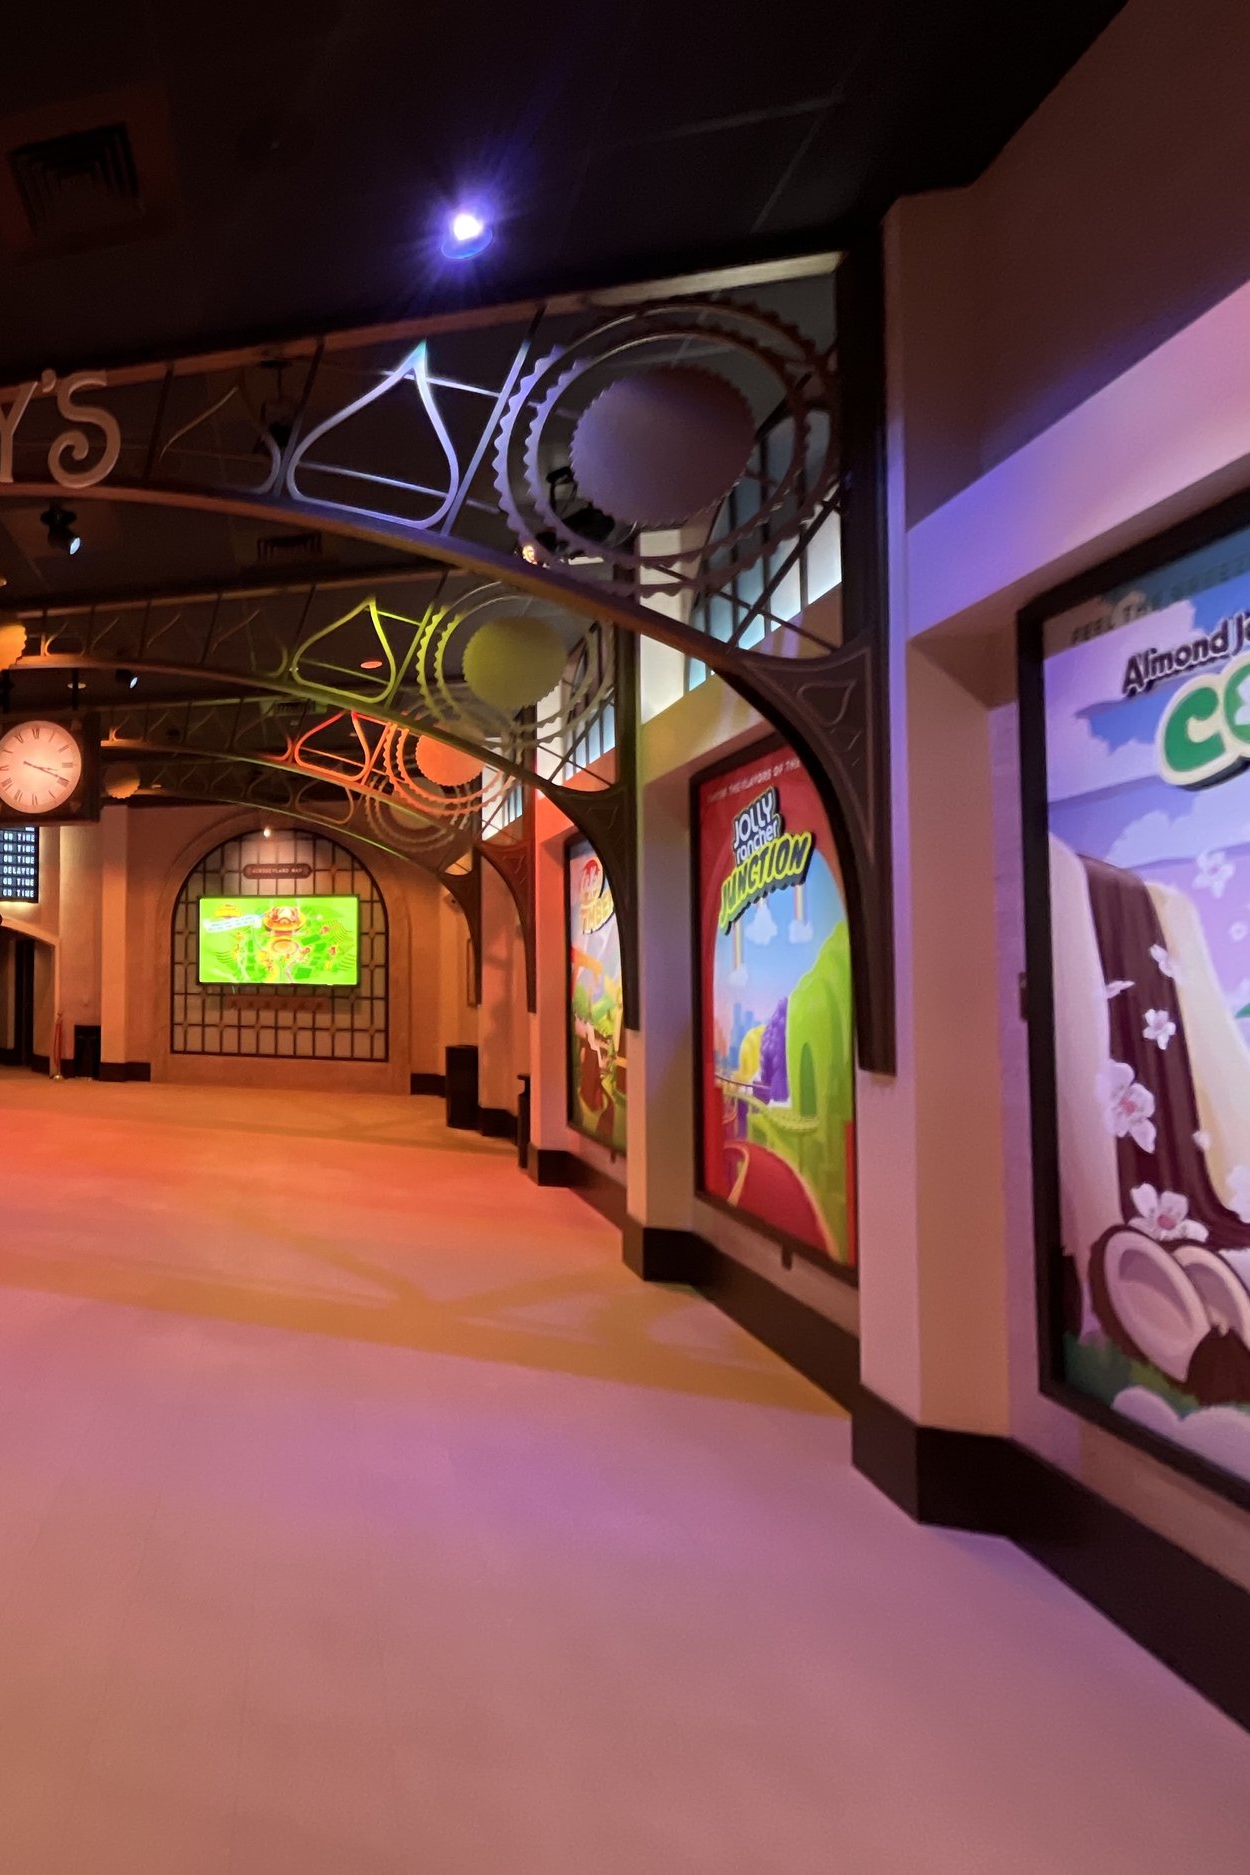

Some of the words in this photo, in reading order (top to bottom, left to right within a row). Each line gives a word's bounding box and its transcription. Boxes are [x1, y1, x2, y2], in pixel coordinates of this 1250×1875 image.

[1122, 617, 1228, 695] Almond
[734, 791, 773, 849] JOLLY
[18, 834, 35, 842] TIME
[18, 845, 35, 853] TIME
[736, 820, 779, 864] rancher
[18, 856, 35, 864] TIME
[719, 831, 812, 928] JUNCTION
[17, 890, 34, 898] TIME
